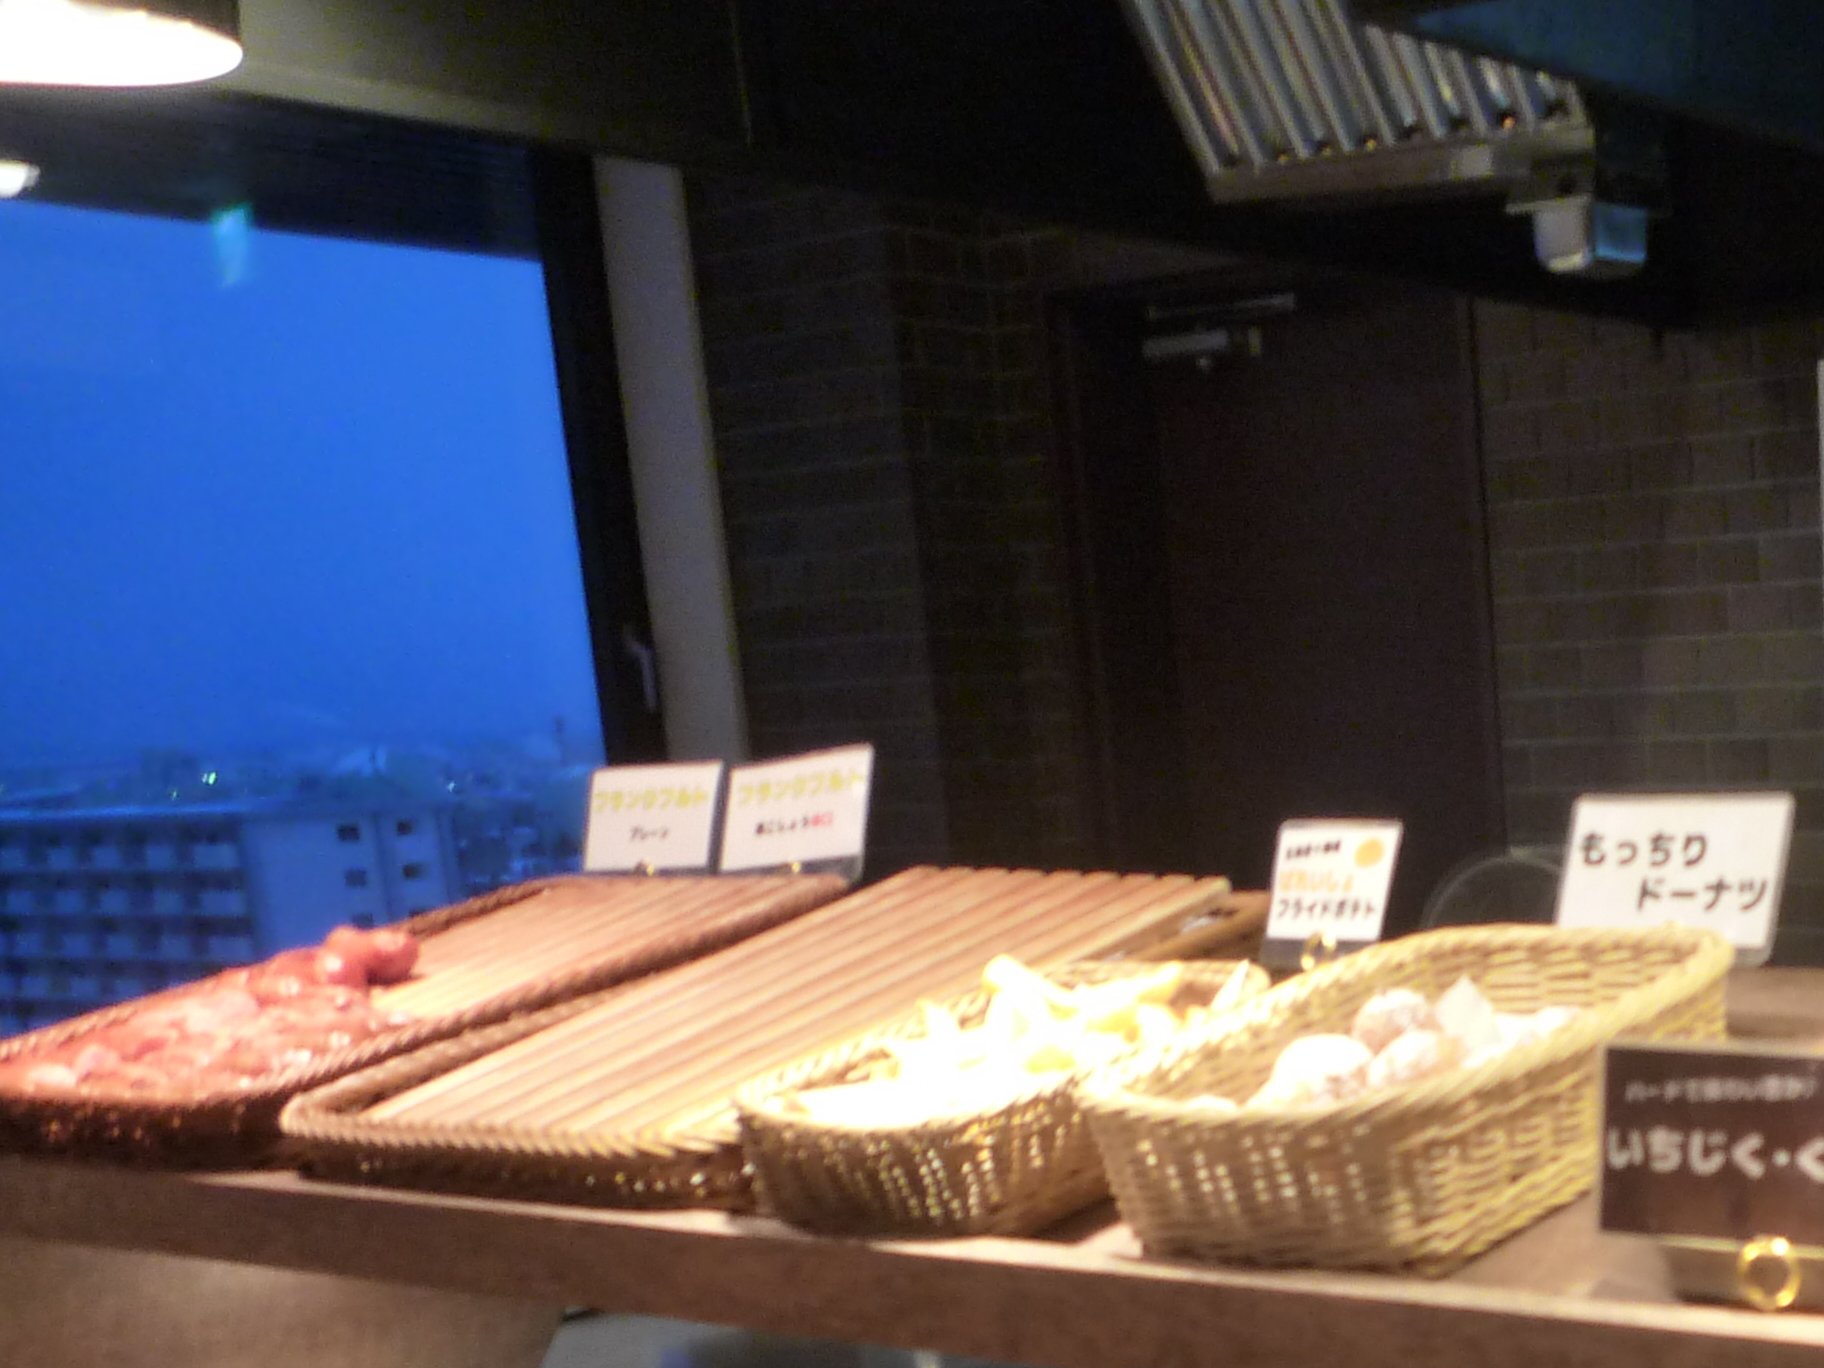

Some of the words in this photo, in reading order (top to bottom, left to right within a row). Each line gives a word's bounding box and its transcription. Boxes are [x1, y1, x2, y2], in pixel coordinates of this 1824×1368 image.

[1578, 831, 1709, 867] もっちり
[1276, 897, 1376, 921] フライドポテト
[1635, 877, 1769, 913] ドーナツ
